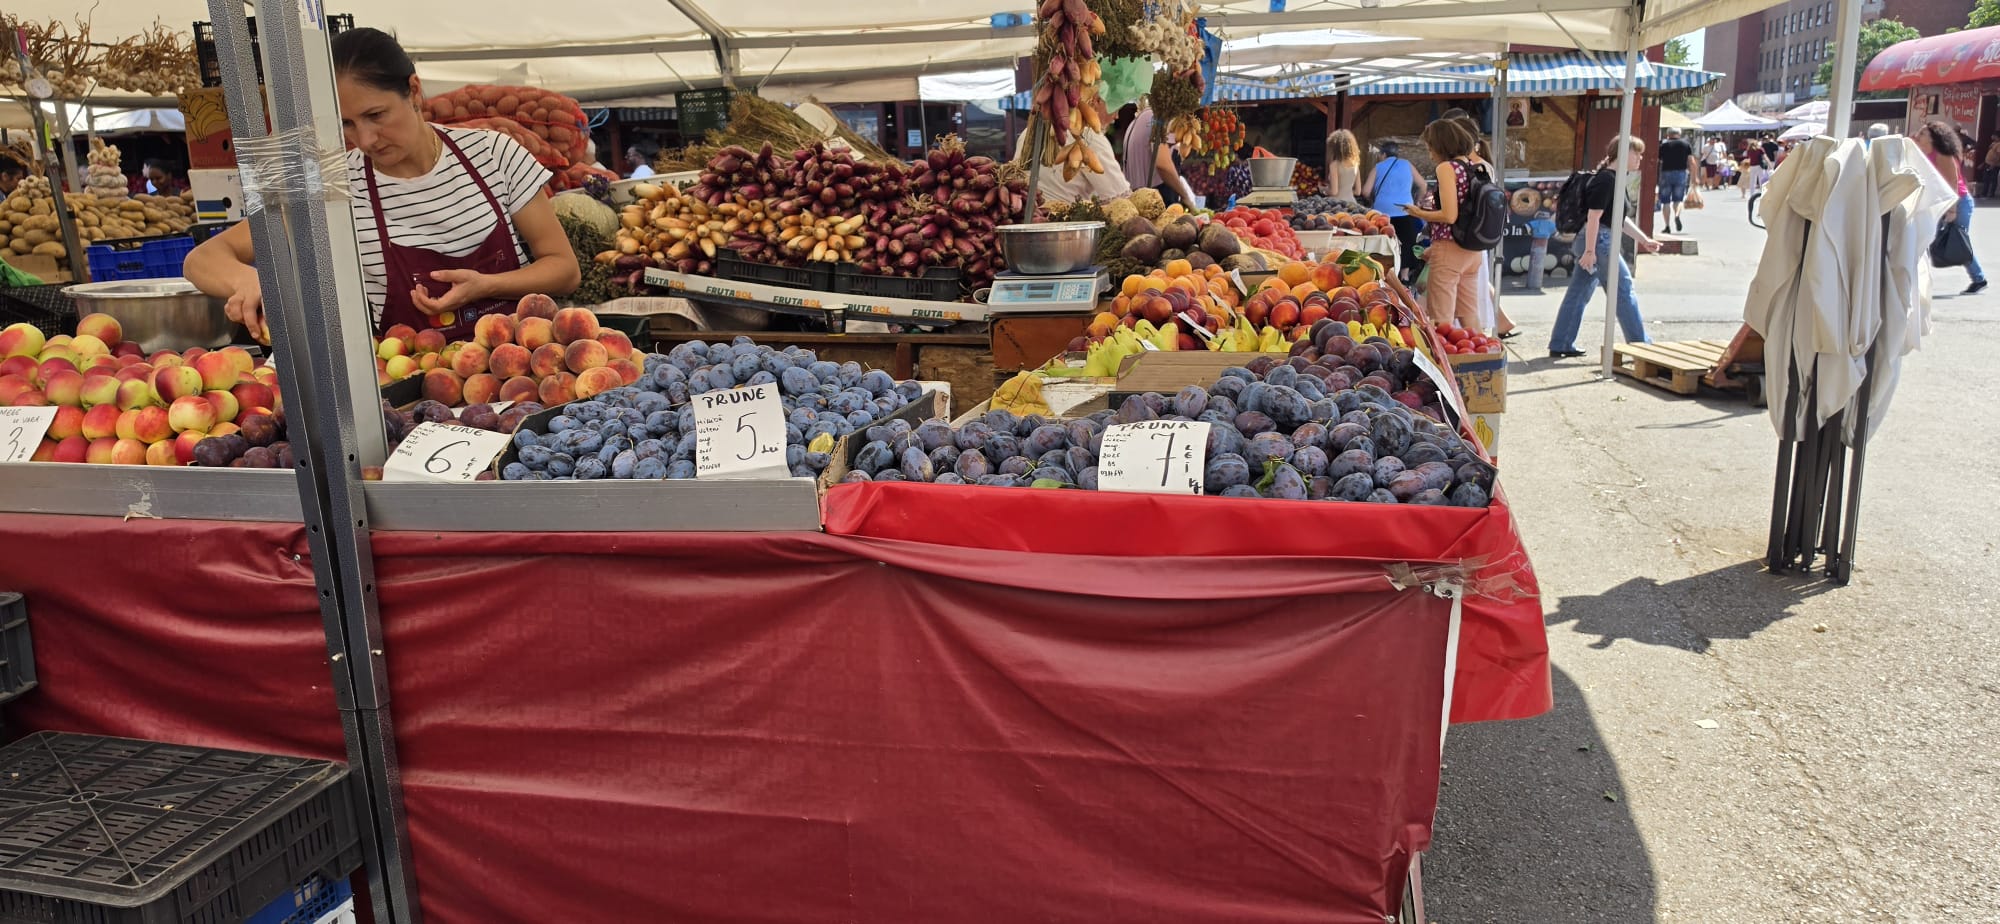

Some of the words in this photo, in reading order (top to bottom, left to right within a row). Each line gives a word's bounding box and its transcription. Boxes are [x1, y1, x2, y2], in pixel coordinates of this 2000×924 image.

[1511, 225, 1523, 236] la
[644, 275, 686, 290] RUTASOL
[706, 285, 753, 300] FRUTASOL
[773, 295, 822, 308] FRUTASOL
[912, 308, 962, 320] FRUTASOL
[702, 387, 766, 408] PRUNE
[736, 411, 757, 461] 5
[424, 440, 471, 474] 6
[1150, 432, 1177, 487] 7
